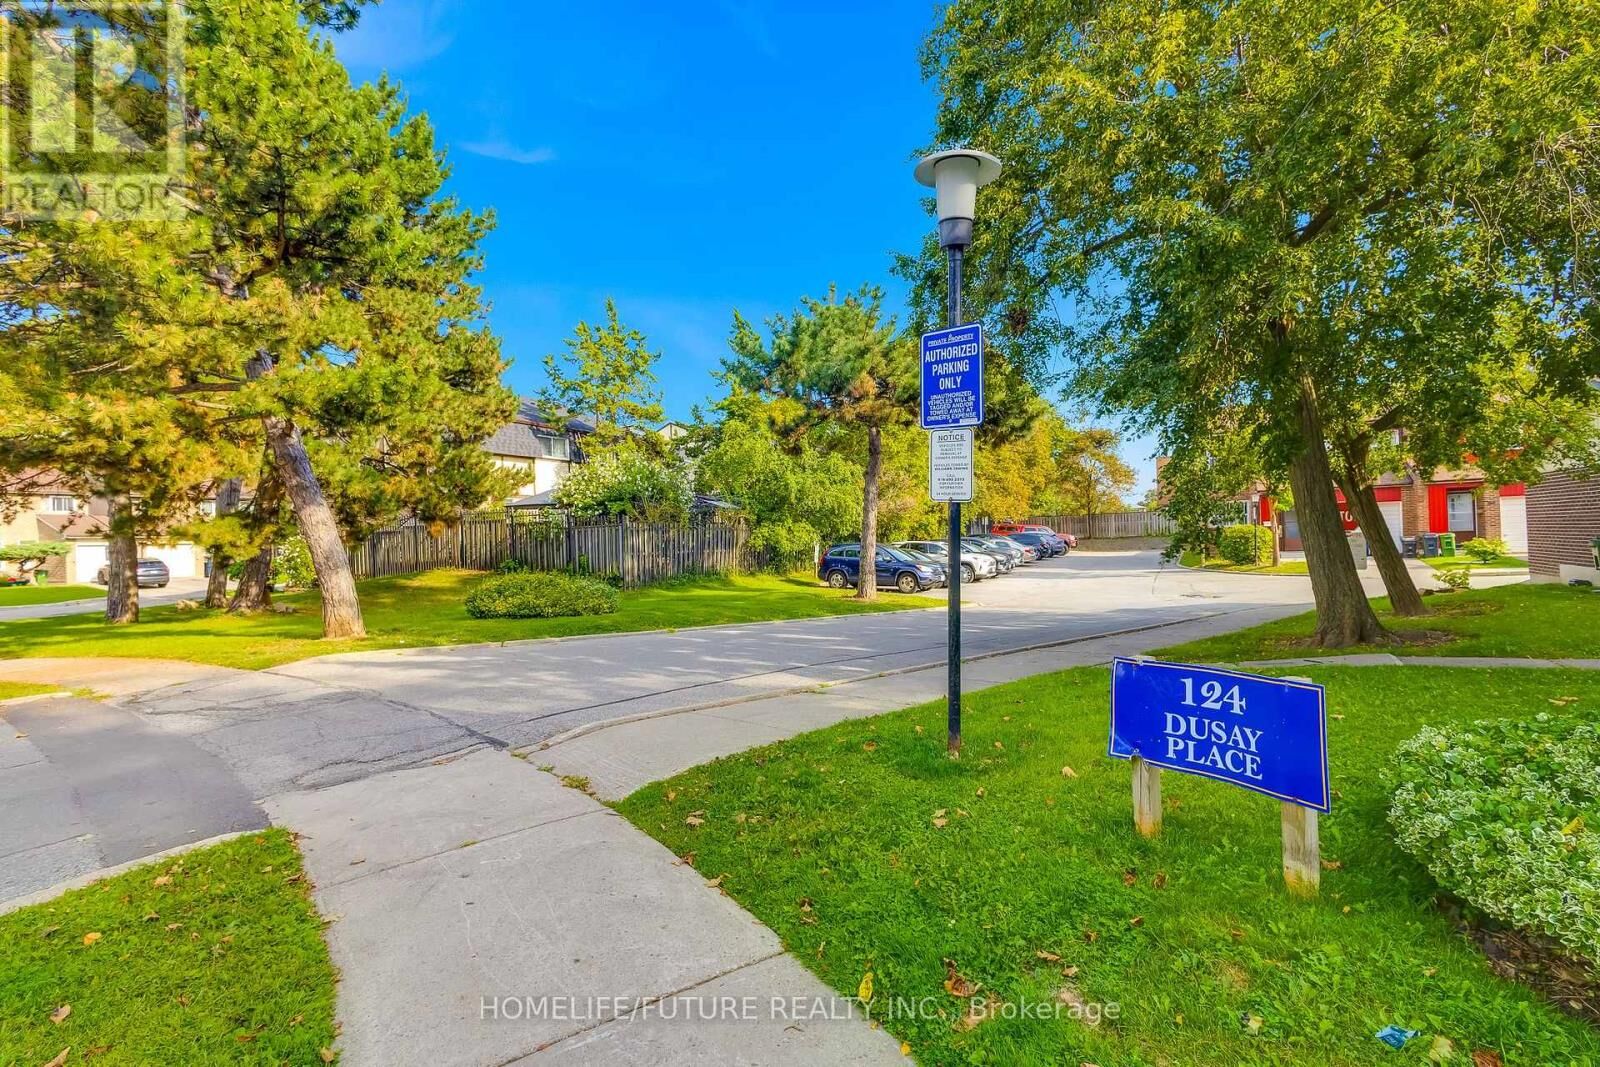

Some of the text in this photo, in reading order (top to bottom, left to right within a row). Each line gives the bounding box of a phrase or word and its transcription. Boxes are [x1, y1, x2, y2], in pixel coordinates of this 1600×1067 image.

[928, 334, 973, 347] PRIVATE PROPERTY
[925, 343, 978, 363] AUTHORIZED
[932, 359, 970, 376] PARKING
[939, 376, 962, 390] ONLY
[930, 391, 972, 399] UNAUTHORIZED
[928, 399, 953, 407] VEHICLES
[952, 401, 974, 409] AND/OR
[951, 411, 977, 419] EXPENSE
[1180, 677, 1246, 715] 124
[1163, 711, 1264, 753] DUSAY
[1165, 736, 1263, 780] PLACE
